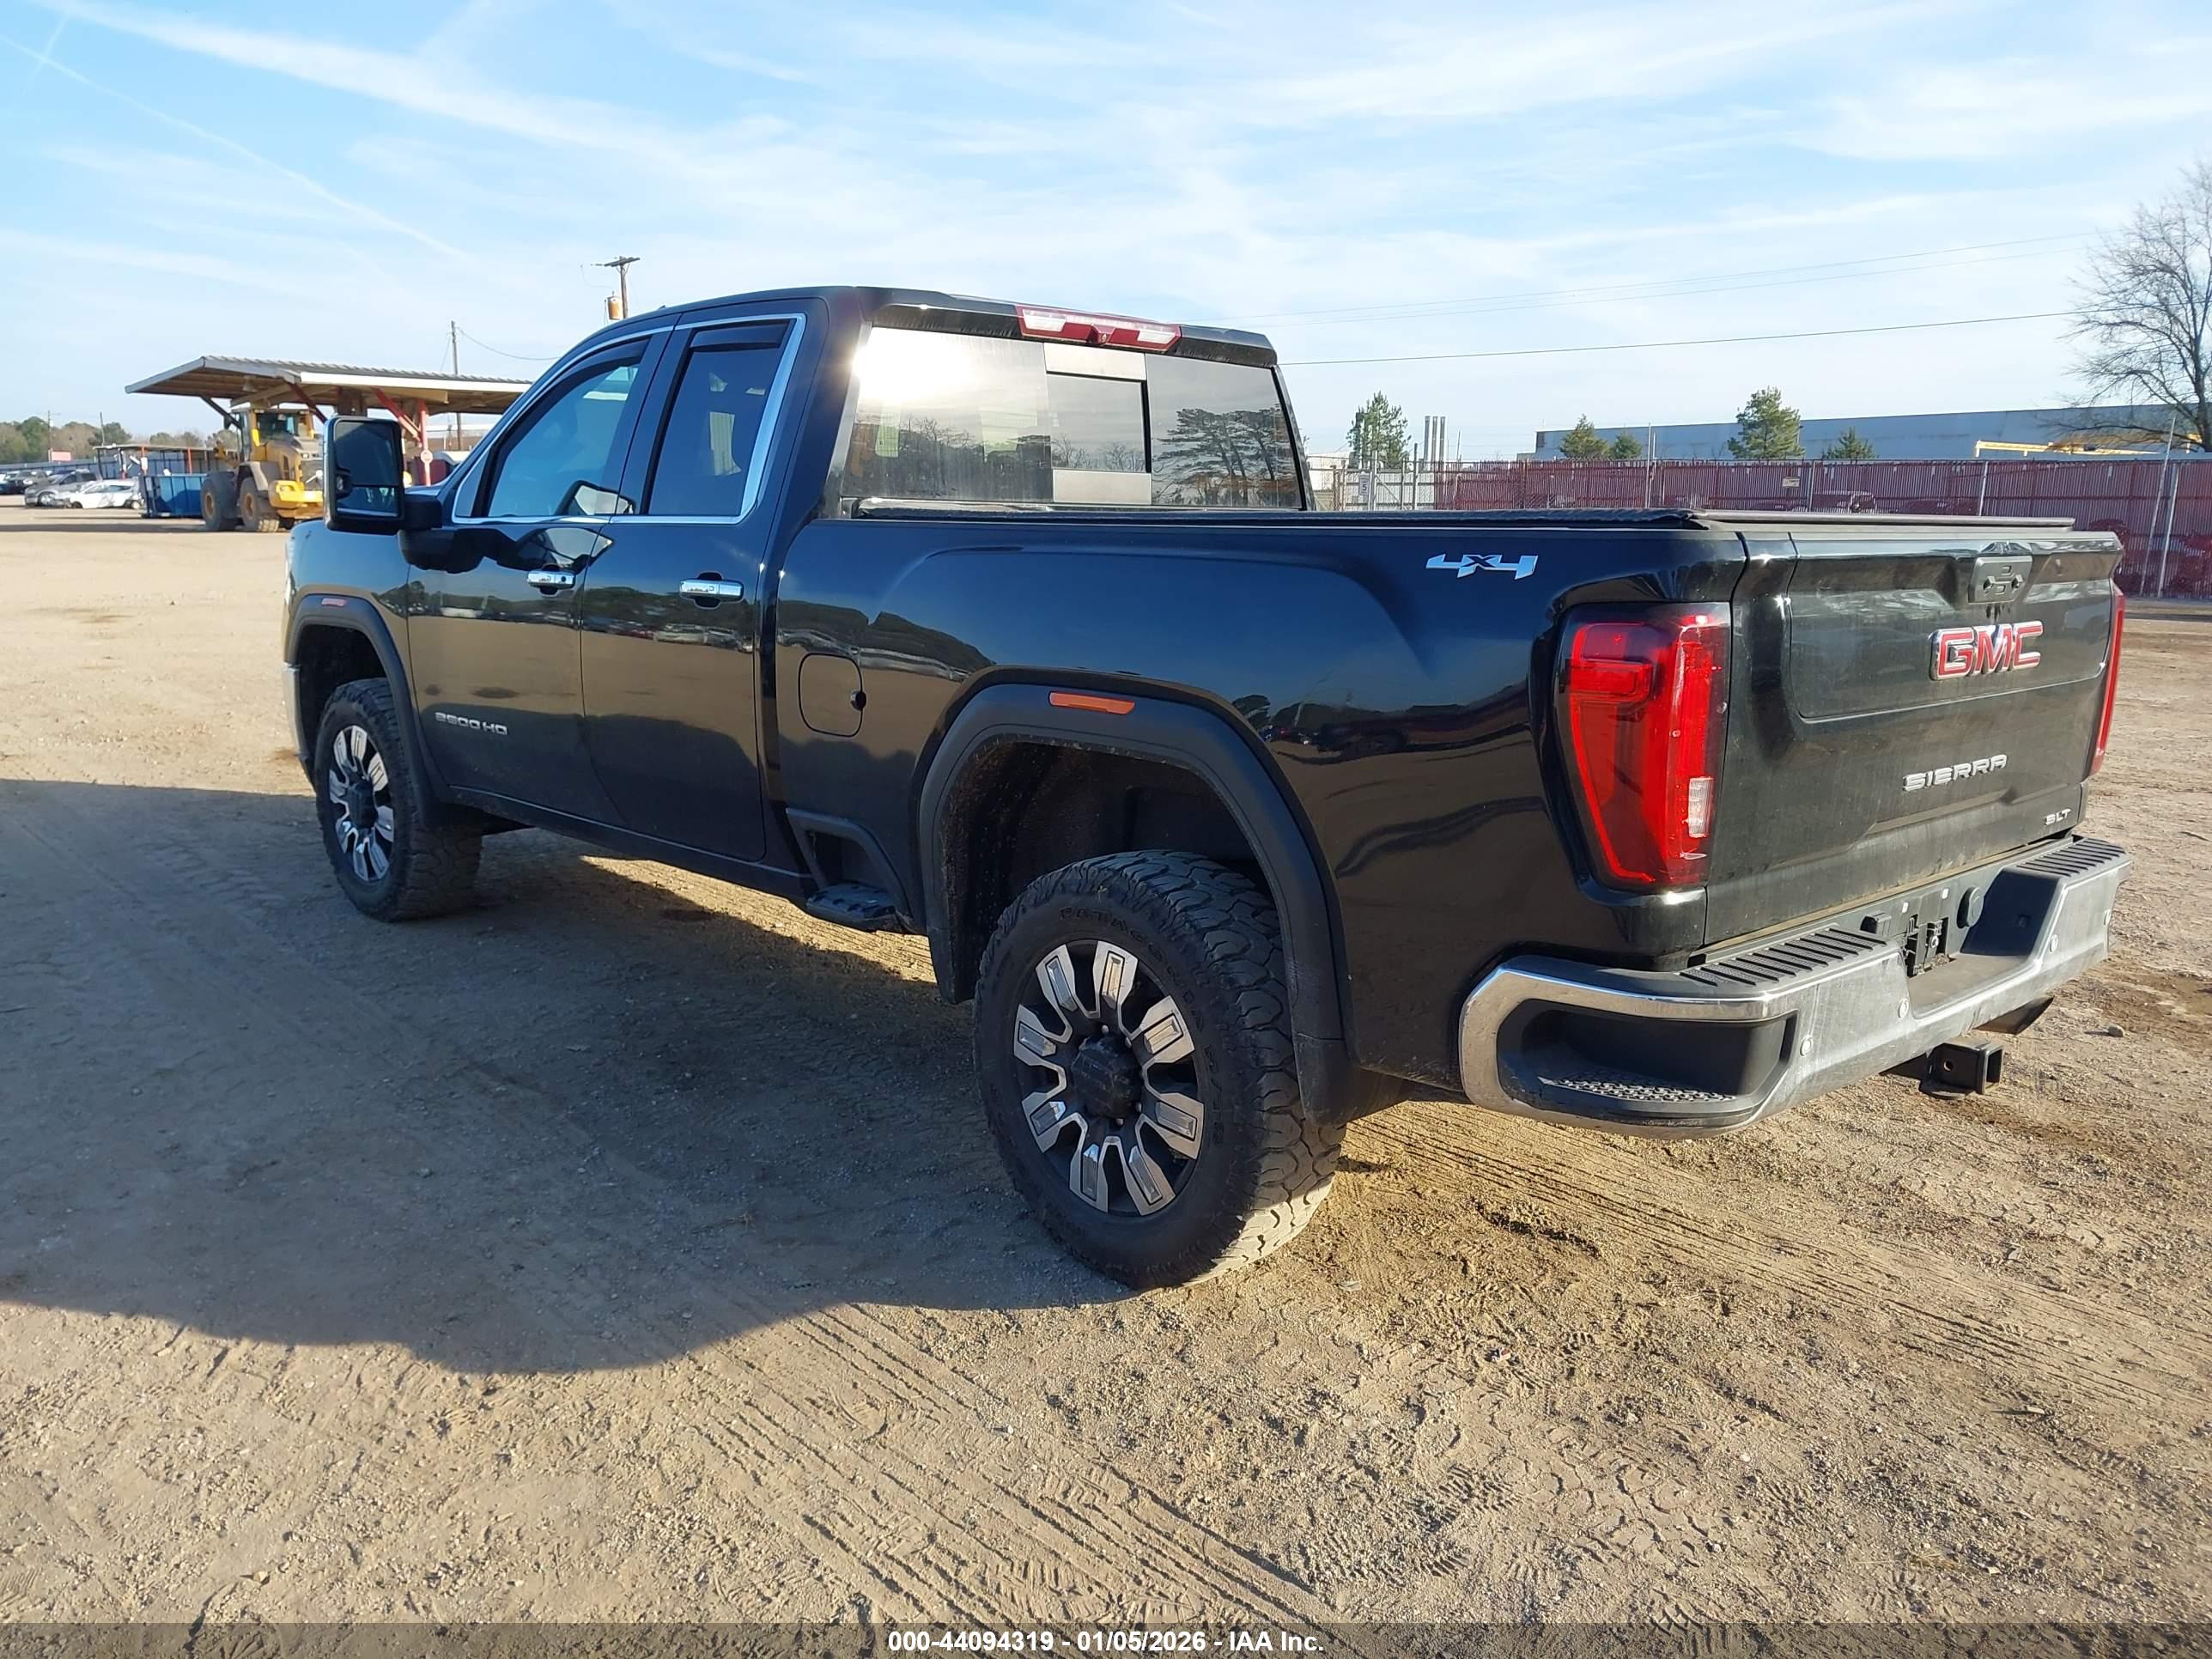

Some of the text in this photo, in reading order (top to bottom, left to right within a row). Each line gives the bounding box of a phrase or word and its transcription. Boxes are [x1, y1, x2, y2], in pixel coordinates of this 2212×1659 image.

[1929, 621, 2044, 680] GMC
[1902, 754, 2008, 792] SIERRA
[2044, 808, 2071, 825] SLT
